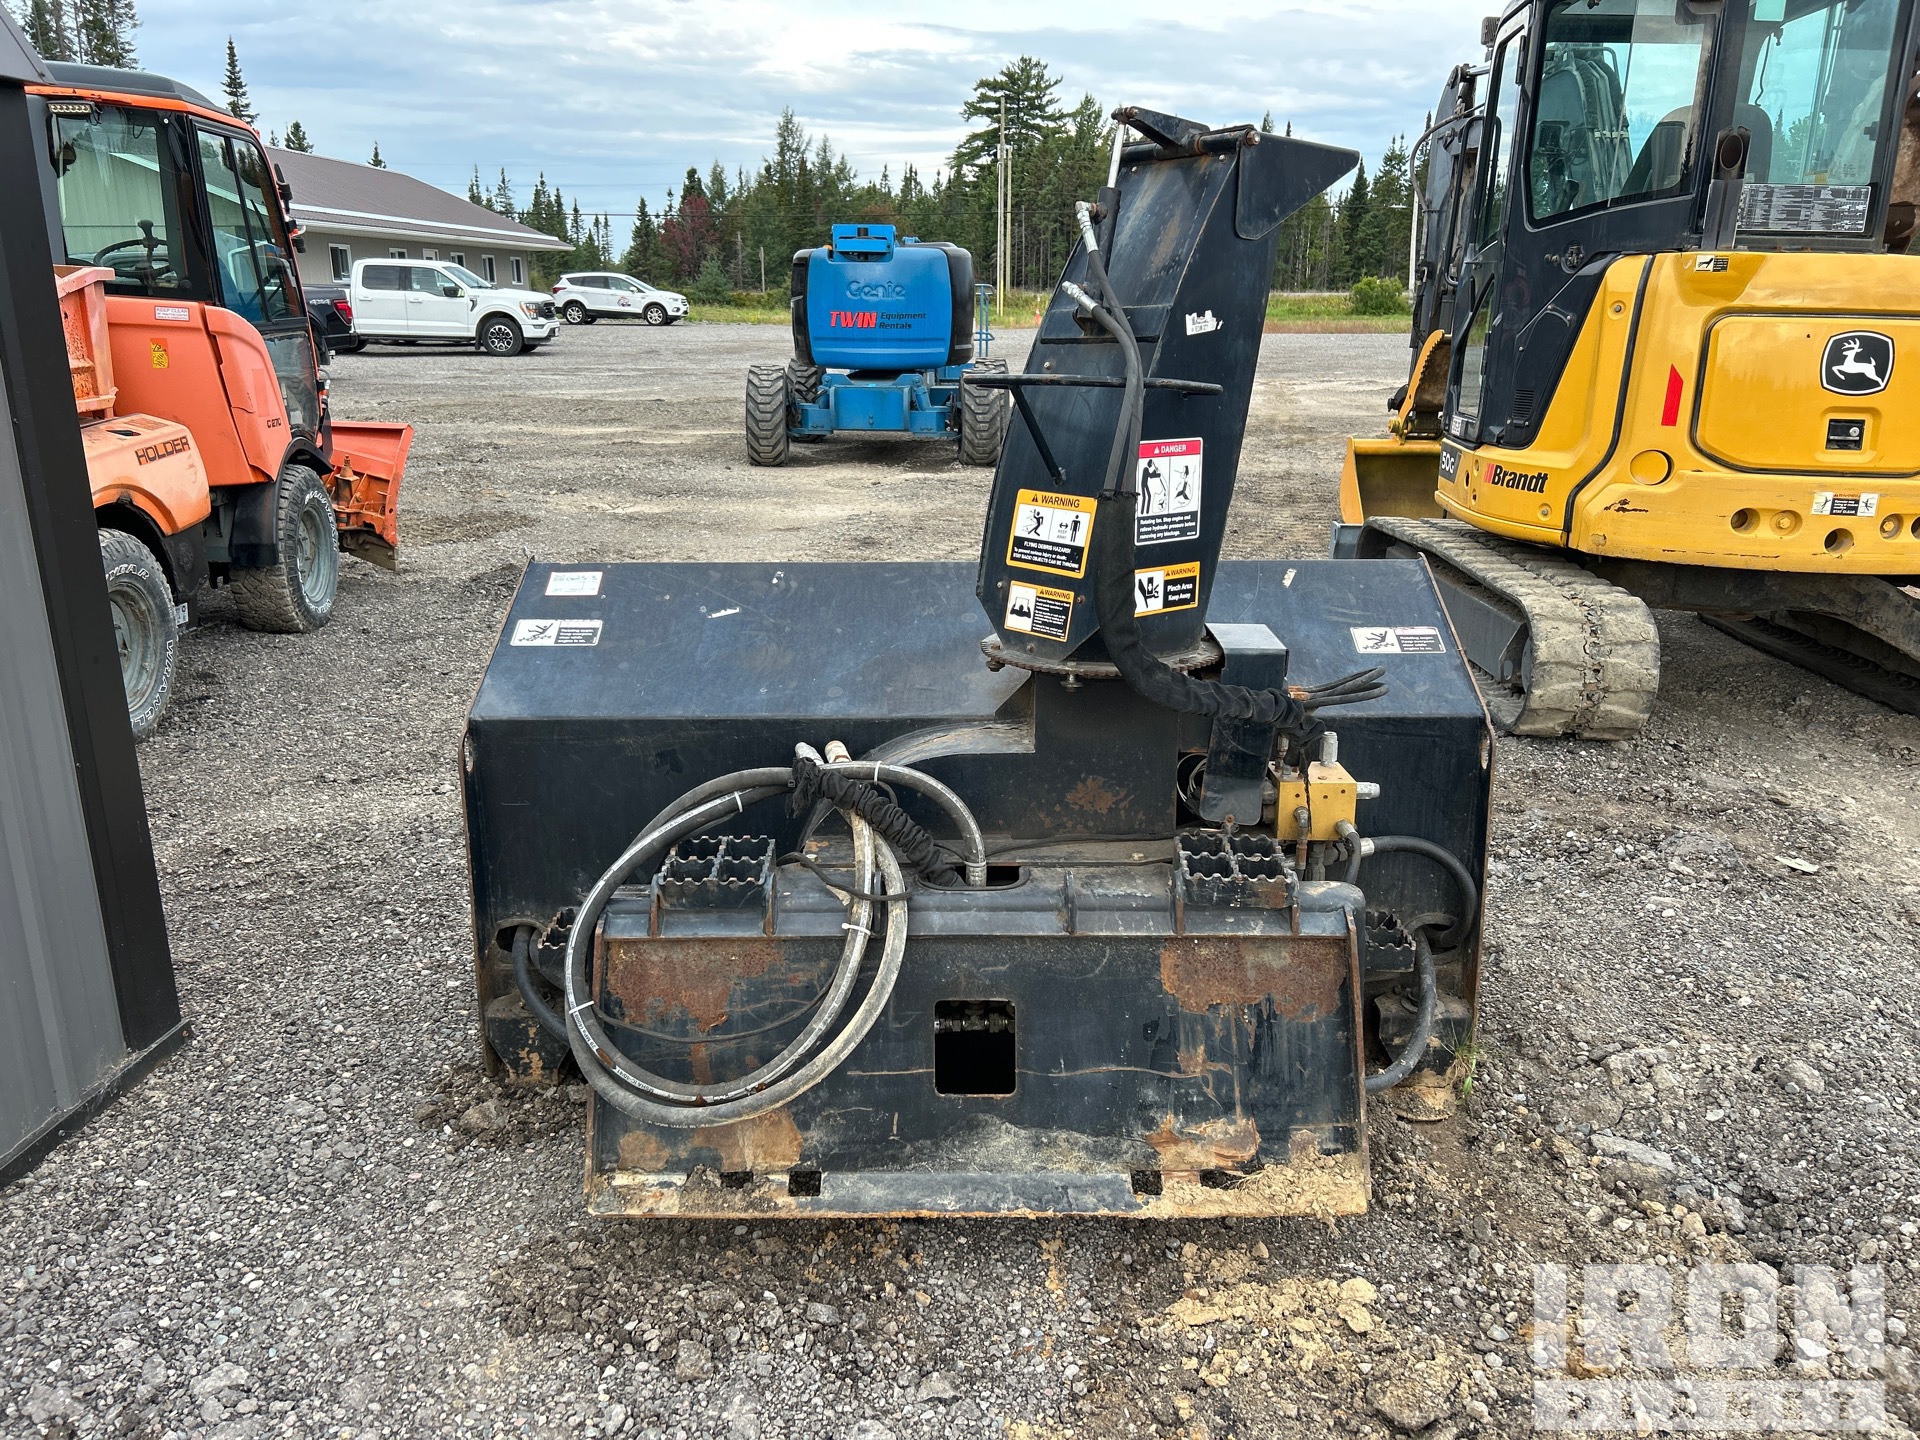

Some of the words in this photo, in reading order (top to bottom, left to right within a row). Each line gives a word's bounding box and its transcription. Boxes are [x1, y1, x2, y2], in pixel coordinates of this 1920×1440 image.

[845, 281, 906, 300] Genie
[830, 311, 877, 328] TWIN
[881, 312, 927, 321] Equipment
[135, 436, 190, 465] HOLDER
[1161, 445, 1187, 453] DANGER
[1441, 451, 1455, 474] 50G
[1492, 464, 1548, 493] Brandt
[1041, 495, 1080, 508] WARNING
[1171, 567, 1195, 576] WARNING
[1045, 589, 1071, 600] WARNING
[1167, 584, 1181, 592] Pinch
